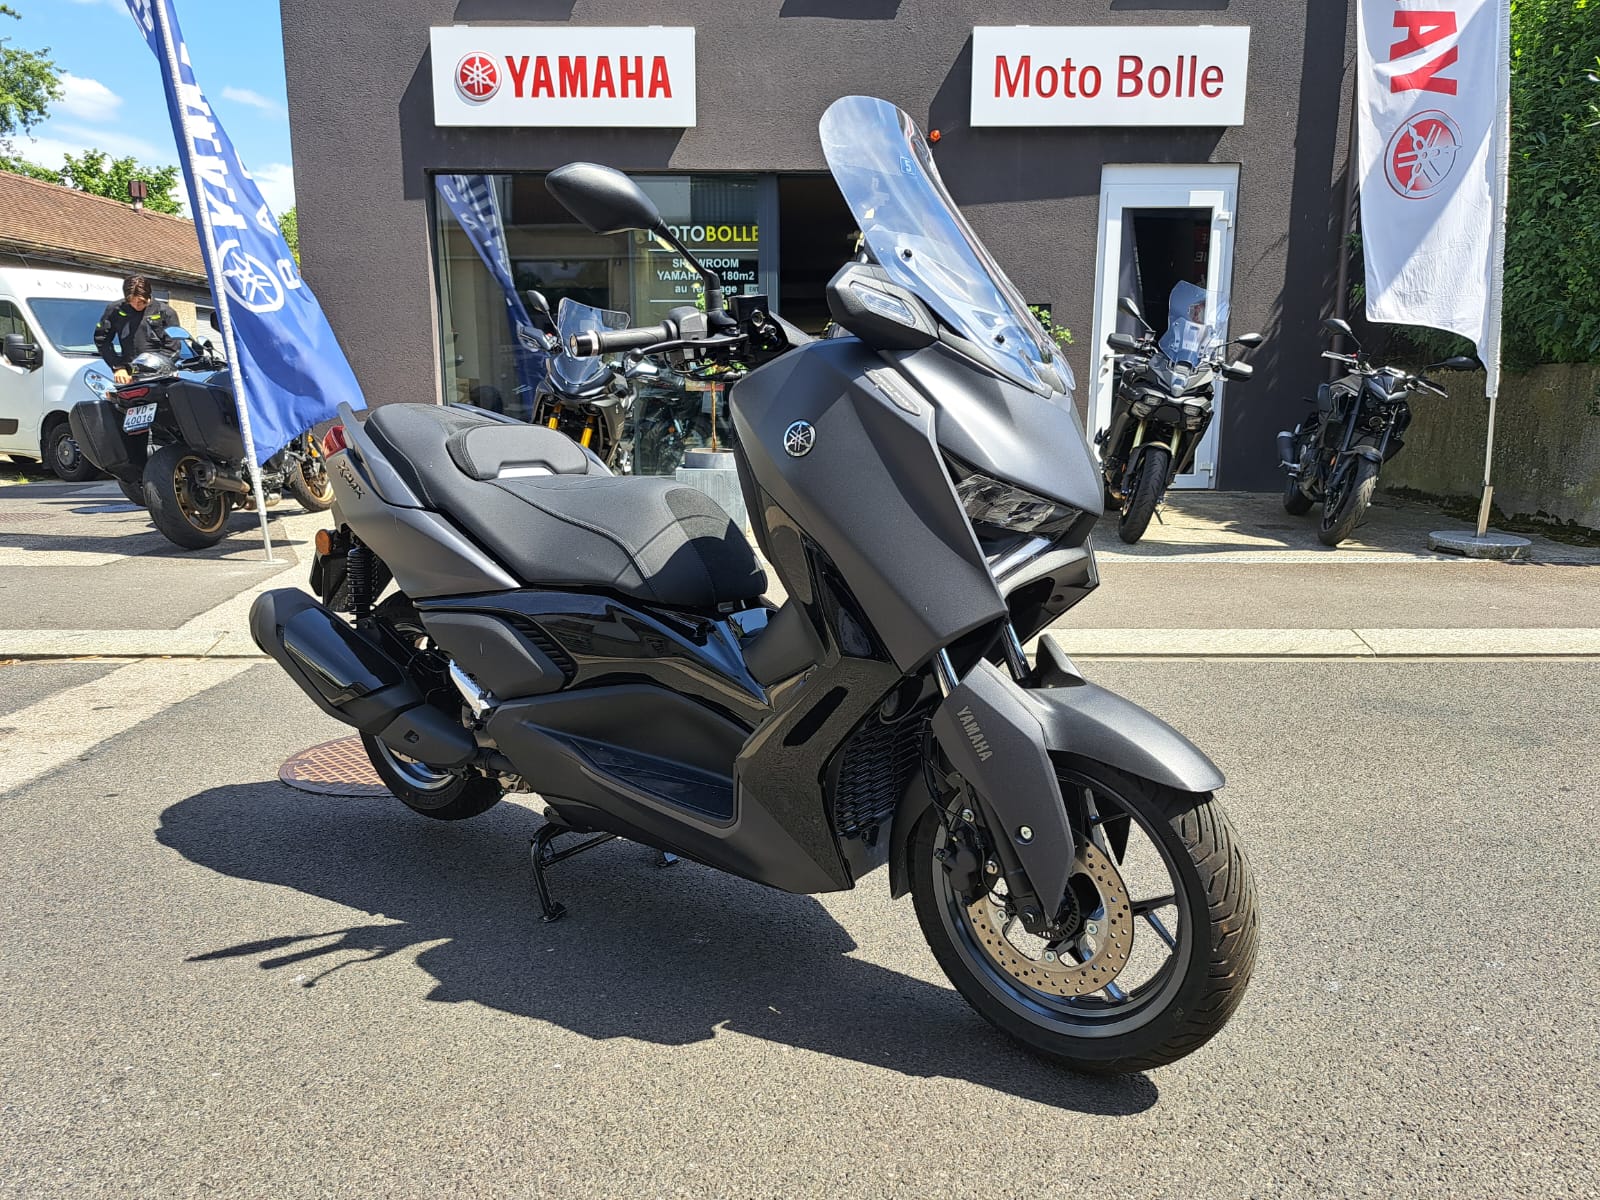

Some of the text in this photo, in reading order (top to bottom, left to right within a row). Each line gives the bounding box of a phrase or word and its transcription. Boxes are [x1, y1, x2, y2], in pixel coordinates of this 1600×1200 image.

[504, 55, 673, 98] YAMAHA
[994, 55, 1224, 98] Moto Bolle
[672, 258, 739, 268] SHWROOM
[657, 270, 755, 281] YAMAHA 180m2
[674, 285, 688, 293] au
[136, 405, 147, 415] VD
[125, 413, 152, 425] 40016
[957, 705, 993, 762] YAMAHA
